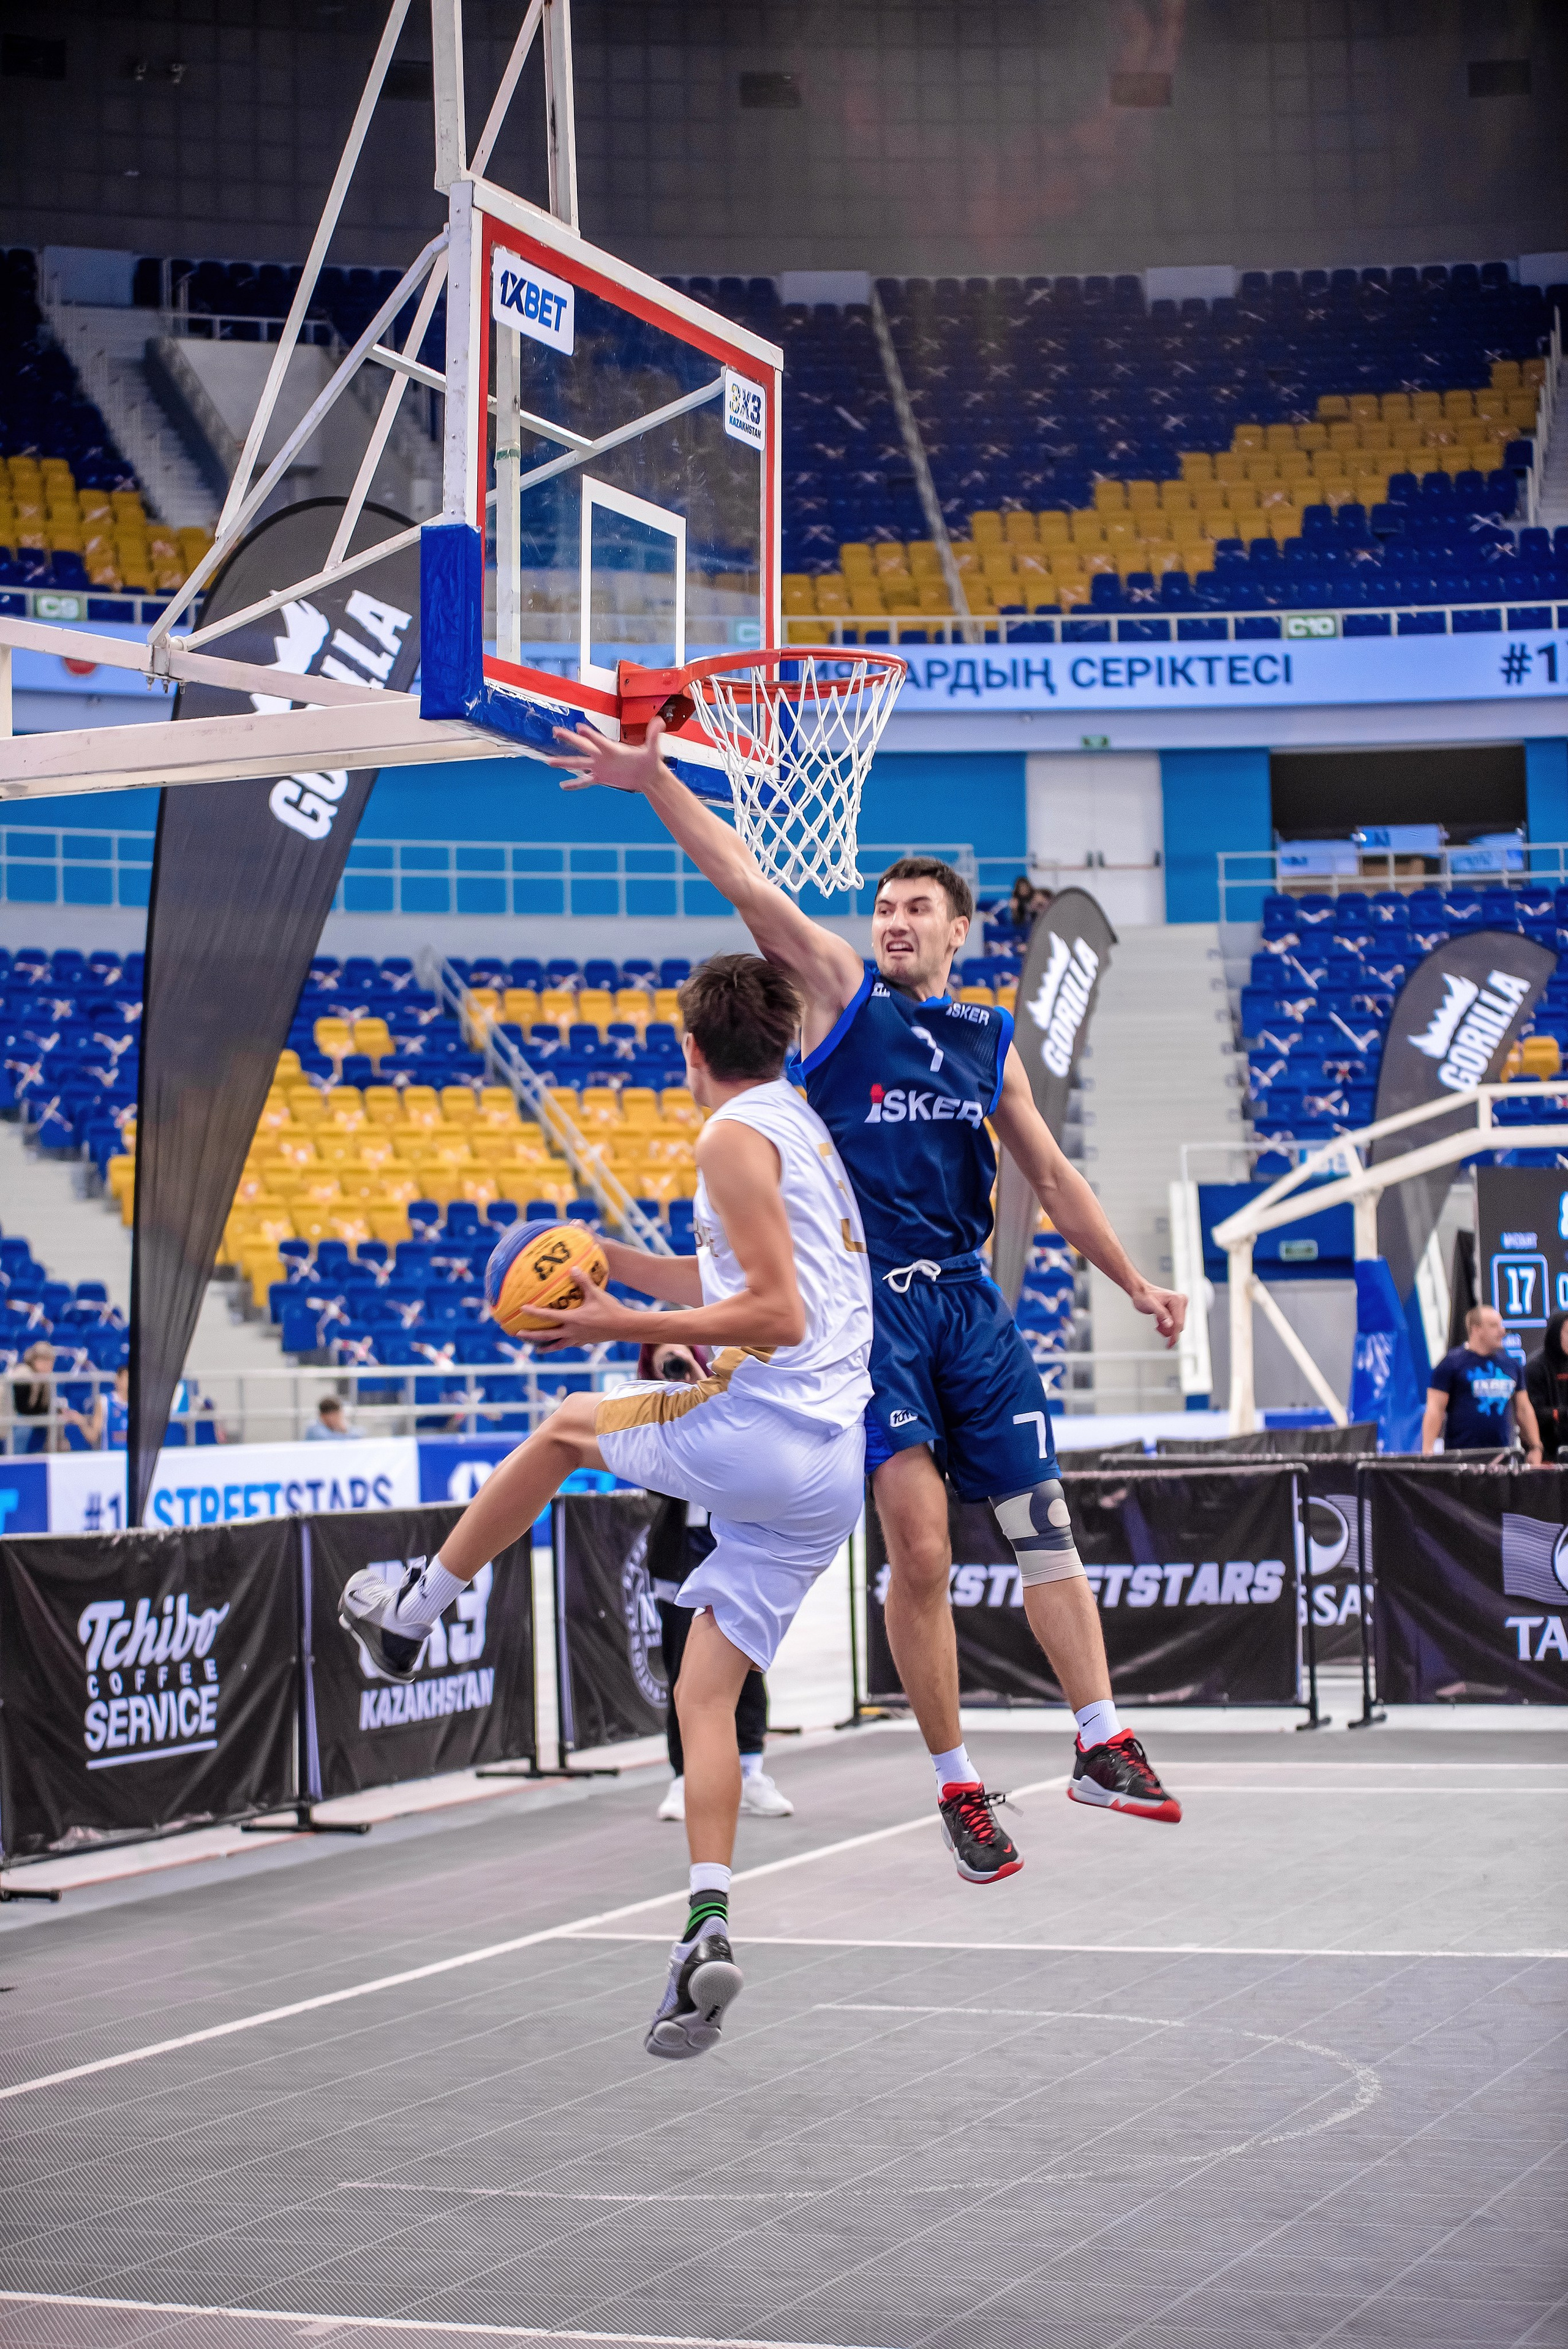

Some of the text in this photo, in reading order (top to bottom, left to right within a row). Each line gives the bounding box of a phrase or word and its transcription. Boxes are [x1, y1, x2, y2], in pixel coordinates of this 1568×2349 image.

[500, 270, 567, 333] 1XBET
[729, 415, 762, 440] KAZAKHSTAN
[1500, 641, 1568, 685] #1
[1042, 936, 1099, 1078] GORILLA
[1438, 969, 1531, 1093] GORILLA
[911, 1026, 944, 1072] 7
[1505, 1265, 1536, 1314] 17
[1012, 1411, 1047, 1458] 7
[78, 1593, 230, 1672] Tchibo
[87, 1658, 217, 1699] COFFEE
[360, 1667, 495, 1731] KAZAKHSTAN
[85, 1684, 219, 1752] SERVICE
